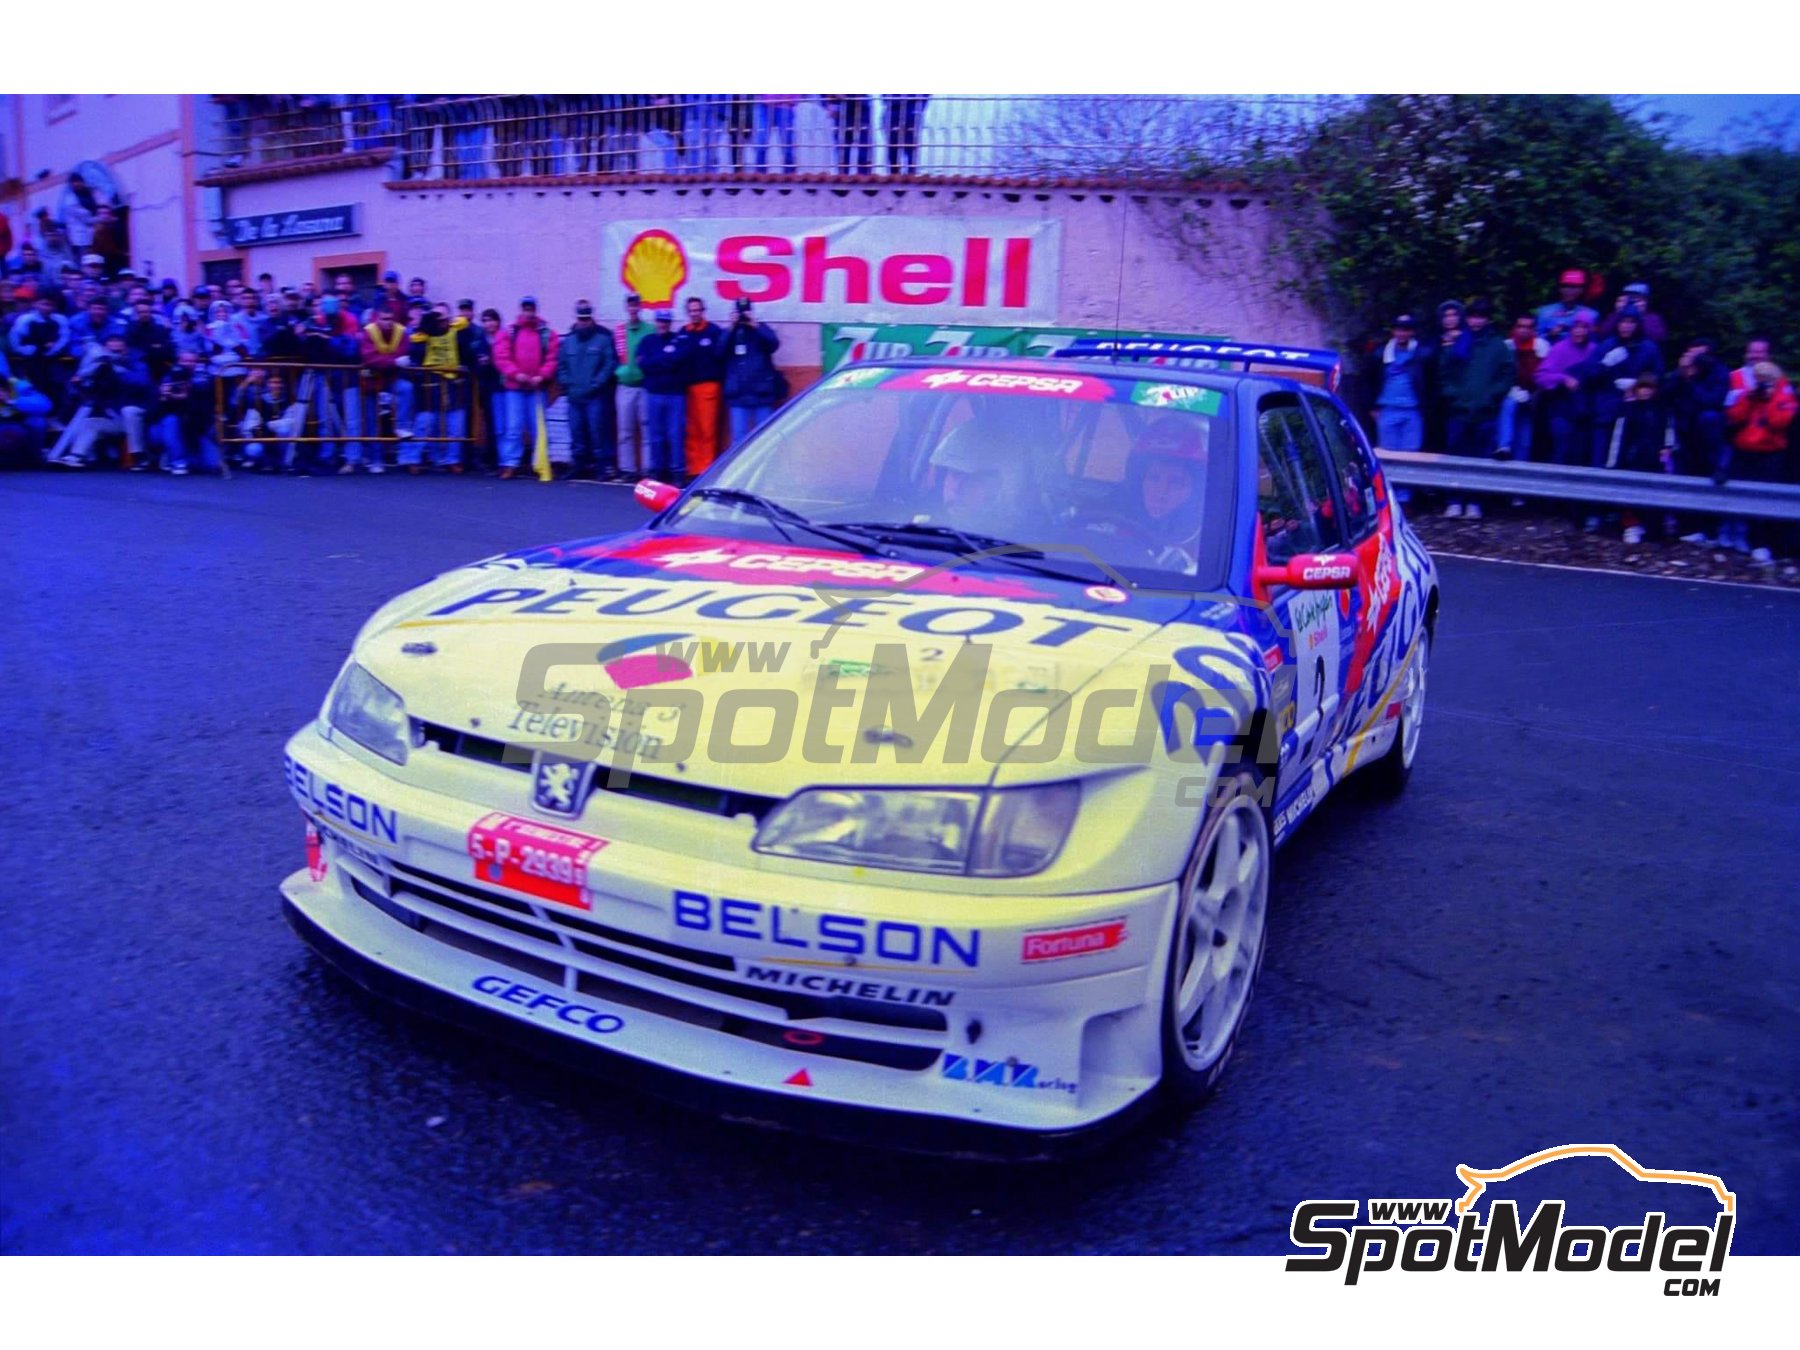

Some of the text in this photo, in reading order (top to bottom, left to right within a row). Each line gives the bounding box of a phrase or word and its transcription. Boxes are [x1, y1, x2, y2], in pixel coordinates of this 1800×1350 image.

[714, 236, 1032, 308] Shell
[966, 373, 1083, 394] CEPSA
[730, 553, 926, 582] CEPSA
[1303, 566, 1351, 581] CEPSA
[426, 587, 1132, 647] PEUGEOT
[919, 648, 945, 662] 2
[673, 889, 981, 968] BELSON
[1026, 932, 1105, 957] Fortuna
[745, 965, 957, 1007] MICHELIN
[471, 975, 625, 1034] GEFCO
